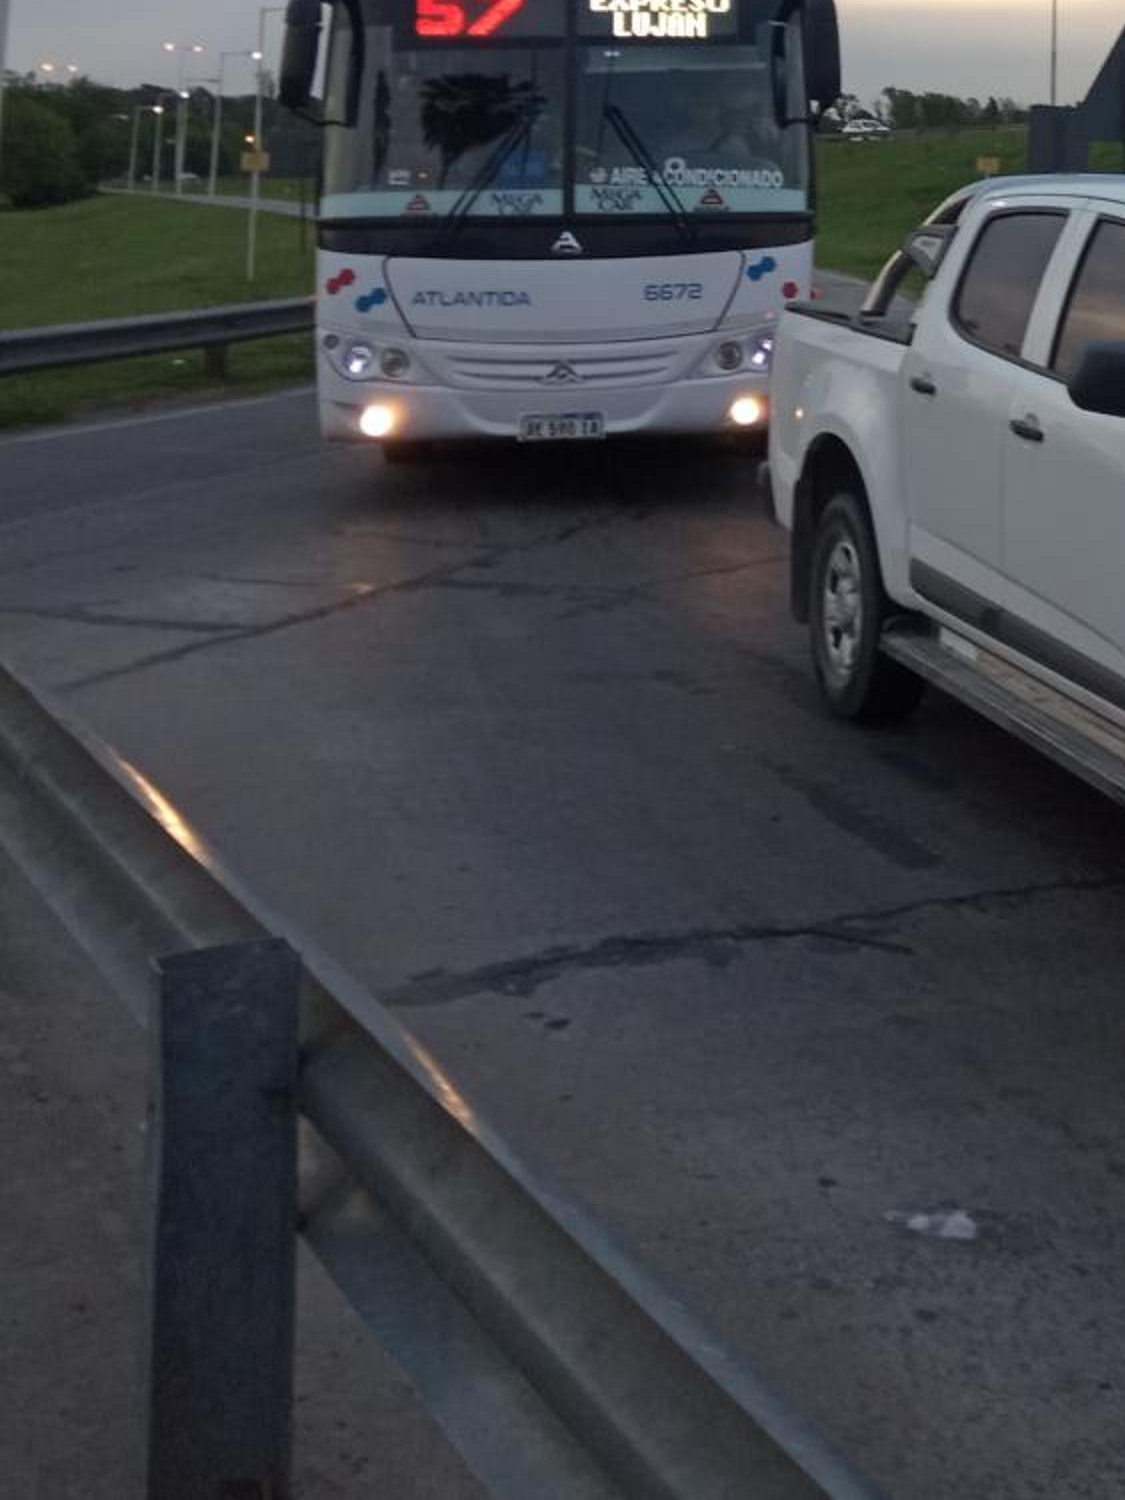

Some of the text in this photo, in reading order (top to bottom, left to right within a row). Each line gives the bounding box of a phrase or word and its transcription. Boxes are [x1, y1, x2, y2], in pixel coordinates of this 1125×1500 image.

[612, 12, 708, 37] LUJAN
[609, 167, 647, 185] AIRE
[411, 291, 532, 307] ATLANTIDA
[643, 283, 704, 301] 6672
